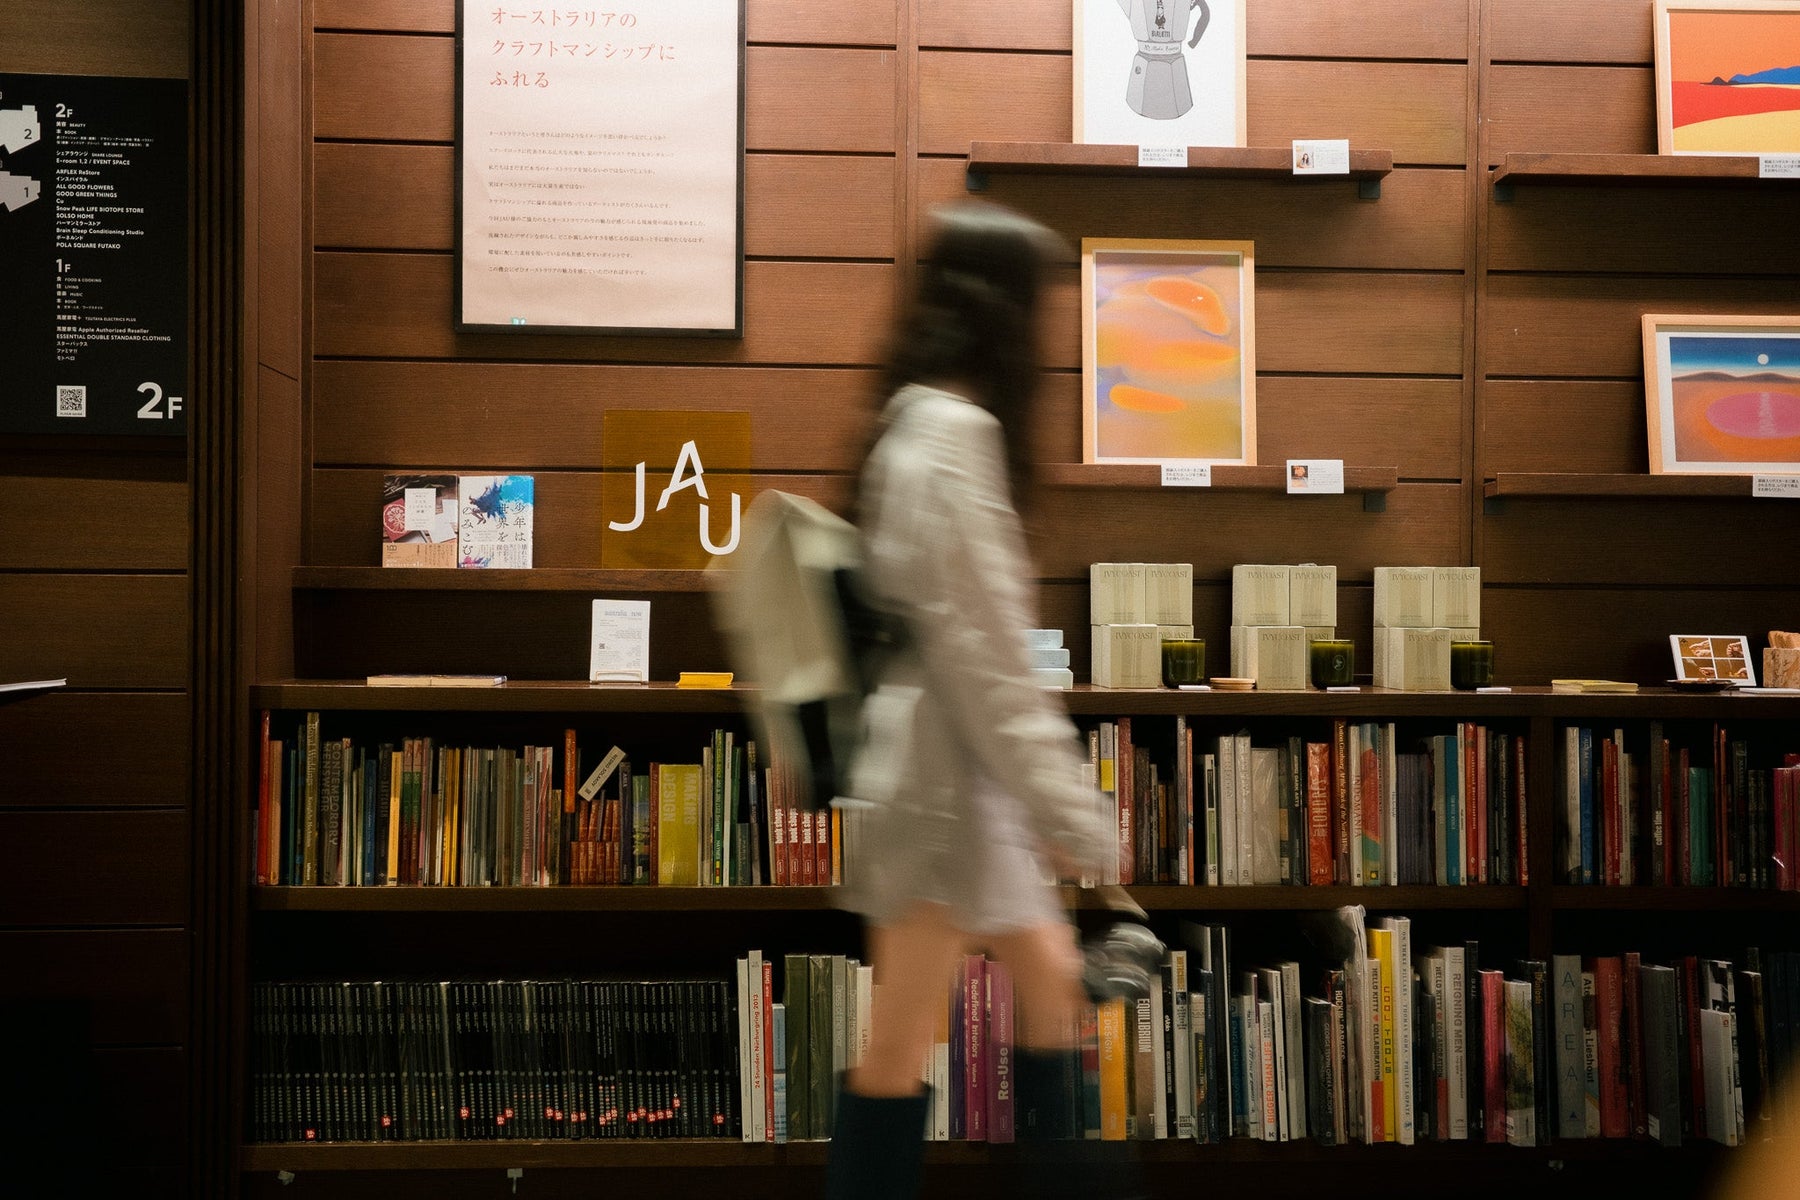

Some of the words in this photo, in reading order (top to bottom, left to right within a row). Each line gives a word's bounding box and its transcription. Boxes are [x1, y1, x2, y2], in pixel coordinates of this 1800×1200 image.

[491, 7, 637, 28] オーストラリアの
[491, 39, 676, 61] クラフトマンシップに
[490, 71, 550, 88] ふれる
[55, 103, 73, 118] 2F
[24, 128, 32, 140] 2
[24, 187, 29, 198] 1
[89, 228, 125, 236] Conditioning
[56, 258, 71, 273] 1F
[137, 381, 183, 419] 2F
[608, 439, 741, 555] JAU
[497, 504, 509, 542] 世界を
[513, 502, 526, 542] 少年は
[1582, 738, 1590, 751] AUDI
[306, 748, 317, 787] Weddings
[320, 742, 332, 814] MENSWEAR
[591, 767, 609, 787] SOLAKOV
[328, 742, 342, 846] CONTEMPORARY
[662, 772, 677, 822] DESIGN
[683, 772, 697, 825] MAKING
[774, 808, 784, 827] shops
[1120, 807, 1131, 828] shops
[1354, 775, 1362, 839] INDOMANIA
[1655, 810, 1663, 825] time
[775, 827, 783, 844] book
[789, 827, 798, 844] book
[803, 827, 812, 844] book
[818, 827, 827, 844] book
[1121, 828, 1130, 844] book
[1655, 825, 1663, 846] coffee
[1401, 931, 1407, 941] ON
[1371, 968, 1379, 991] HELLO
[971, 979, 980, 1022] Redefined
[1383, 986, 1391, 1022] COOL
[1435, 989, 1443, 1011] KITTY
[1453, 973, 1463, 1027] REIGNING
[999, 1001, 1007, 1043] Architecture
[1137, 998, 1152, 1053] EQUILIBRIUM
[1561, 971, 1579, 1083] AREA
[971, 1024, 980, 1058] Interiors
[1103, 1019, 1112, 1052] DESIGN
[1323, 1023, 1331, 1047] GEORGE
[1454, 1029, 1464, 1054] MEN
[1263, 1040, 1272, 1061] LIFE
[1373, 1023, 1381, 1081] COLLABORATION
[1384, 1029, 1392, 1074] TOOLS
[1436, 1021, 1444, 1078] COLLABORATION
[1585, 1038, 1595, 1083] Lieshout
[755, 1080, 761, 1089] 24
[997, 1047, 1009, 1101] Re-Use
[1263, 1062, 1273, 1087] THAN
[1264, 1090, 1275, 1124] BIGGER
